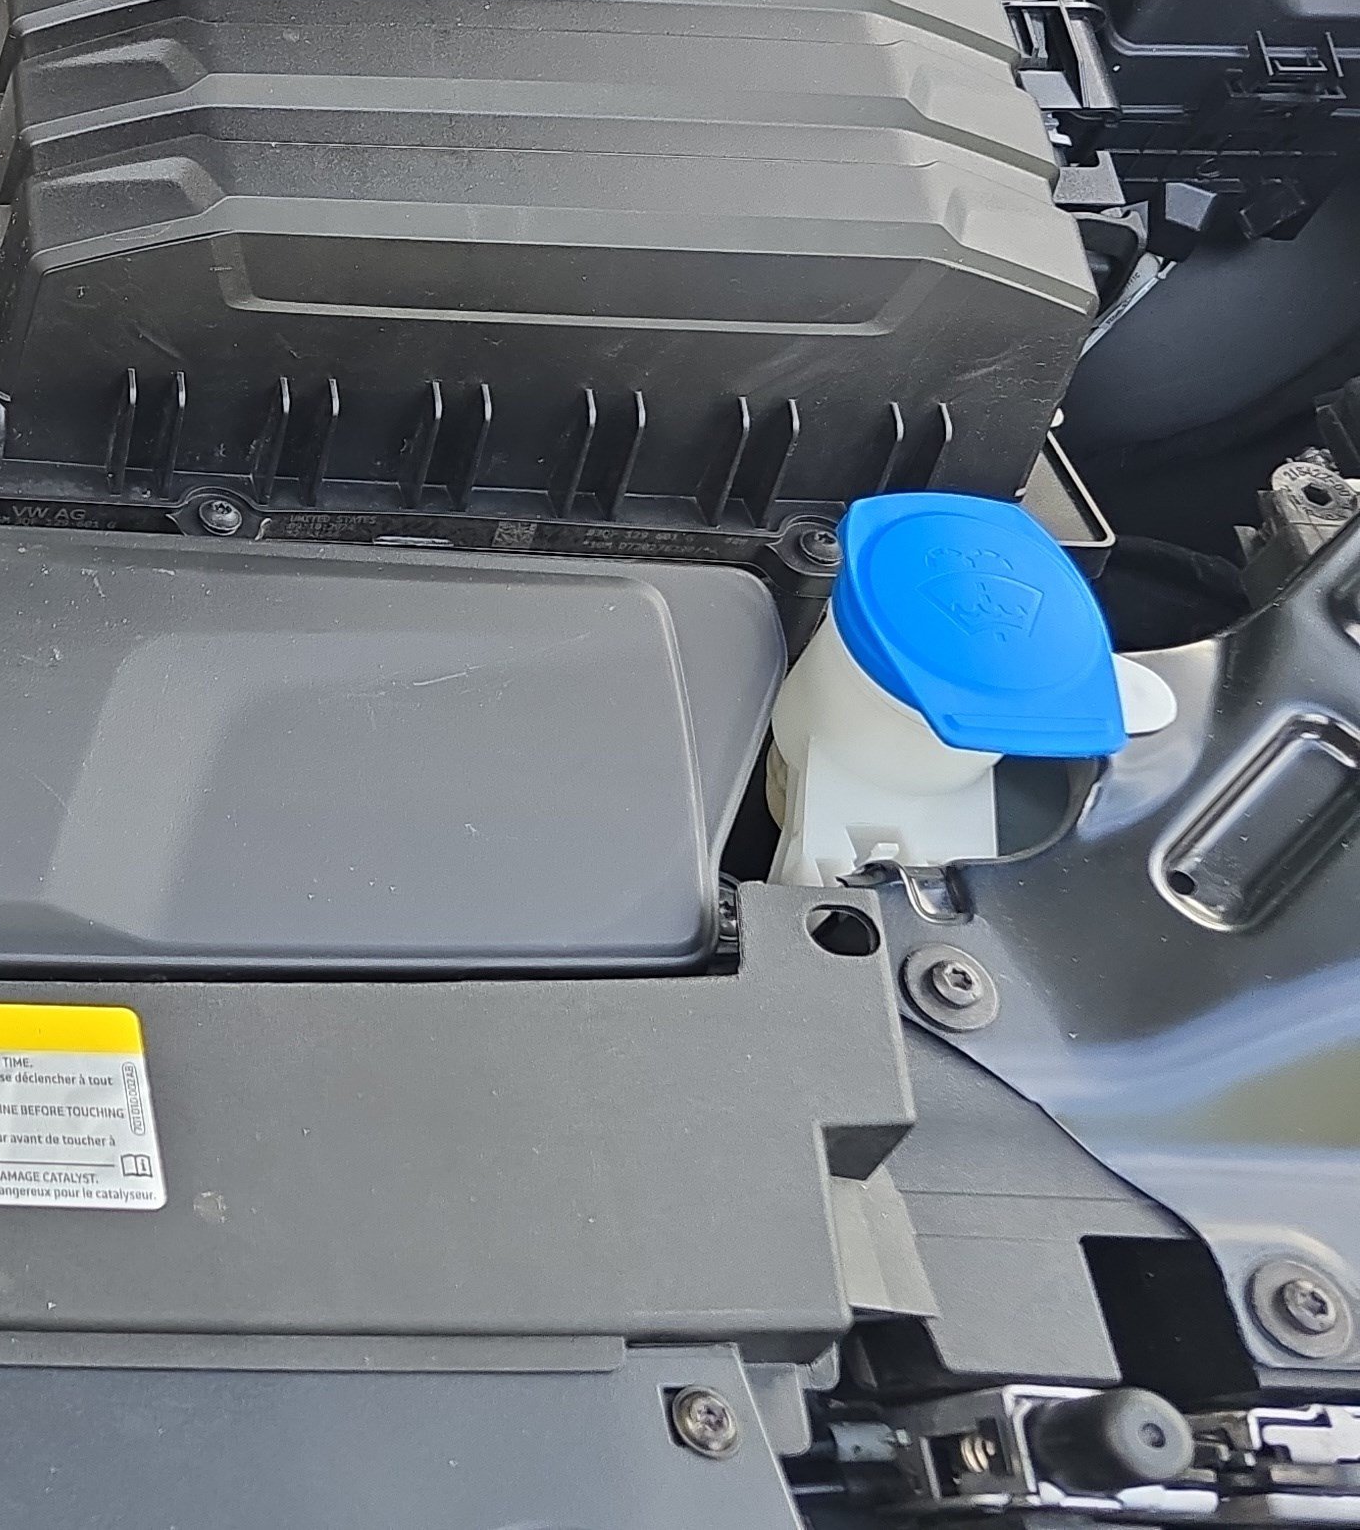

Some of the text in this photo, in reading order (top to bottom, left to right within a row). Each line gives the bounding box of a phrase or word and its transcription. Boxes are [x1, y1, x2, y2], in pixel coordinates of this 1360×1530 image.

[12, 506, 86, 520] VW AG
[2, 1056, 33, 1068] TIME.
[0, 1073, 12, 1082] se
[14, 1072, 75, 1084] déclencher
[78, 1073, 86, 1085] à
[88, 1076, 113, 1086] tout
[20, 1105, 64, 1116] BEFORE
[67, 1106, 124, 1119] TOUCHING
[10, 1134, 42, 1144] avant
[44, 1133, 59, 1145] de
[62, 1135, 105, 1146] toucher
[109, 1134, 116, 1146] à
[42, 1171, 98, 1184] CATALYST.
[53, 1188, 79, 1200] pour
[82, 1186, 93, 1198] le
[95, 1189, 156, 1201] catalyseur.
